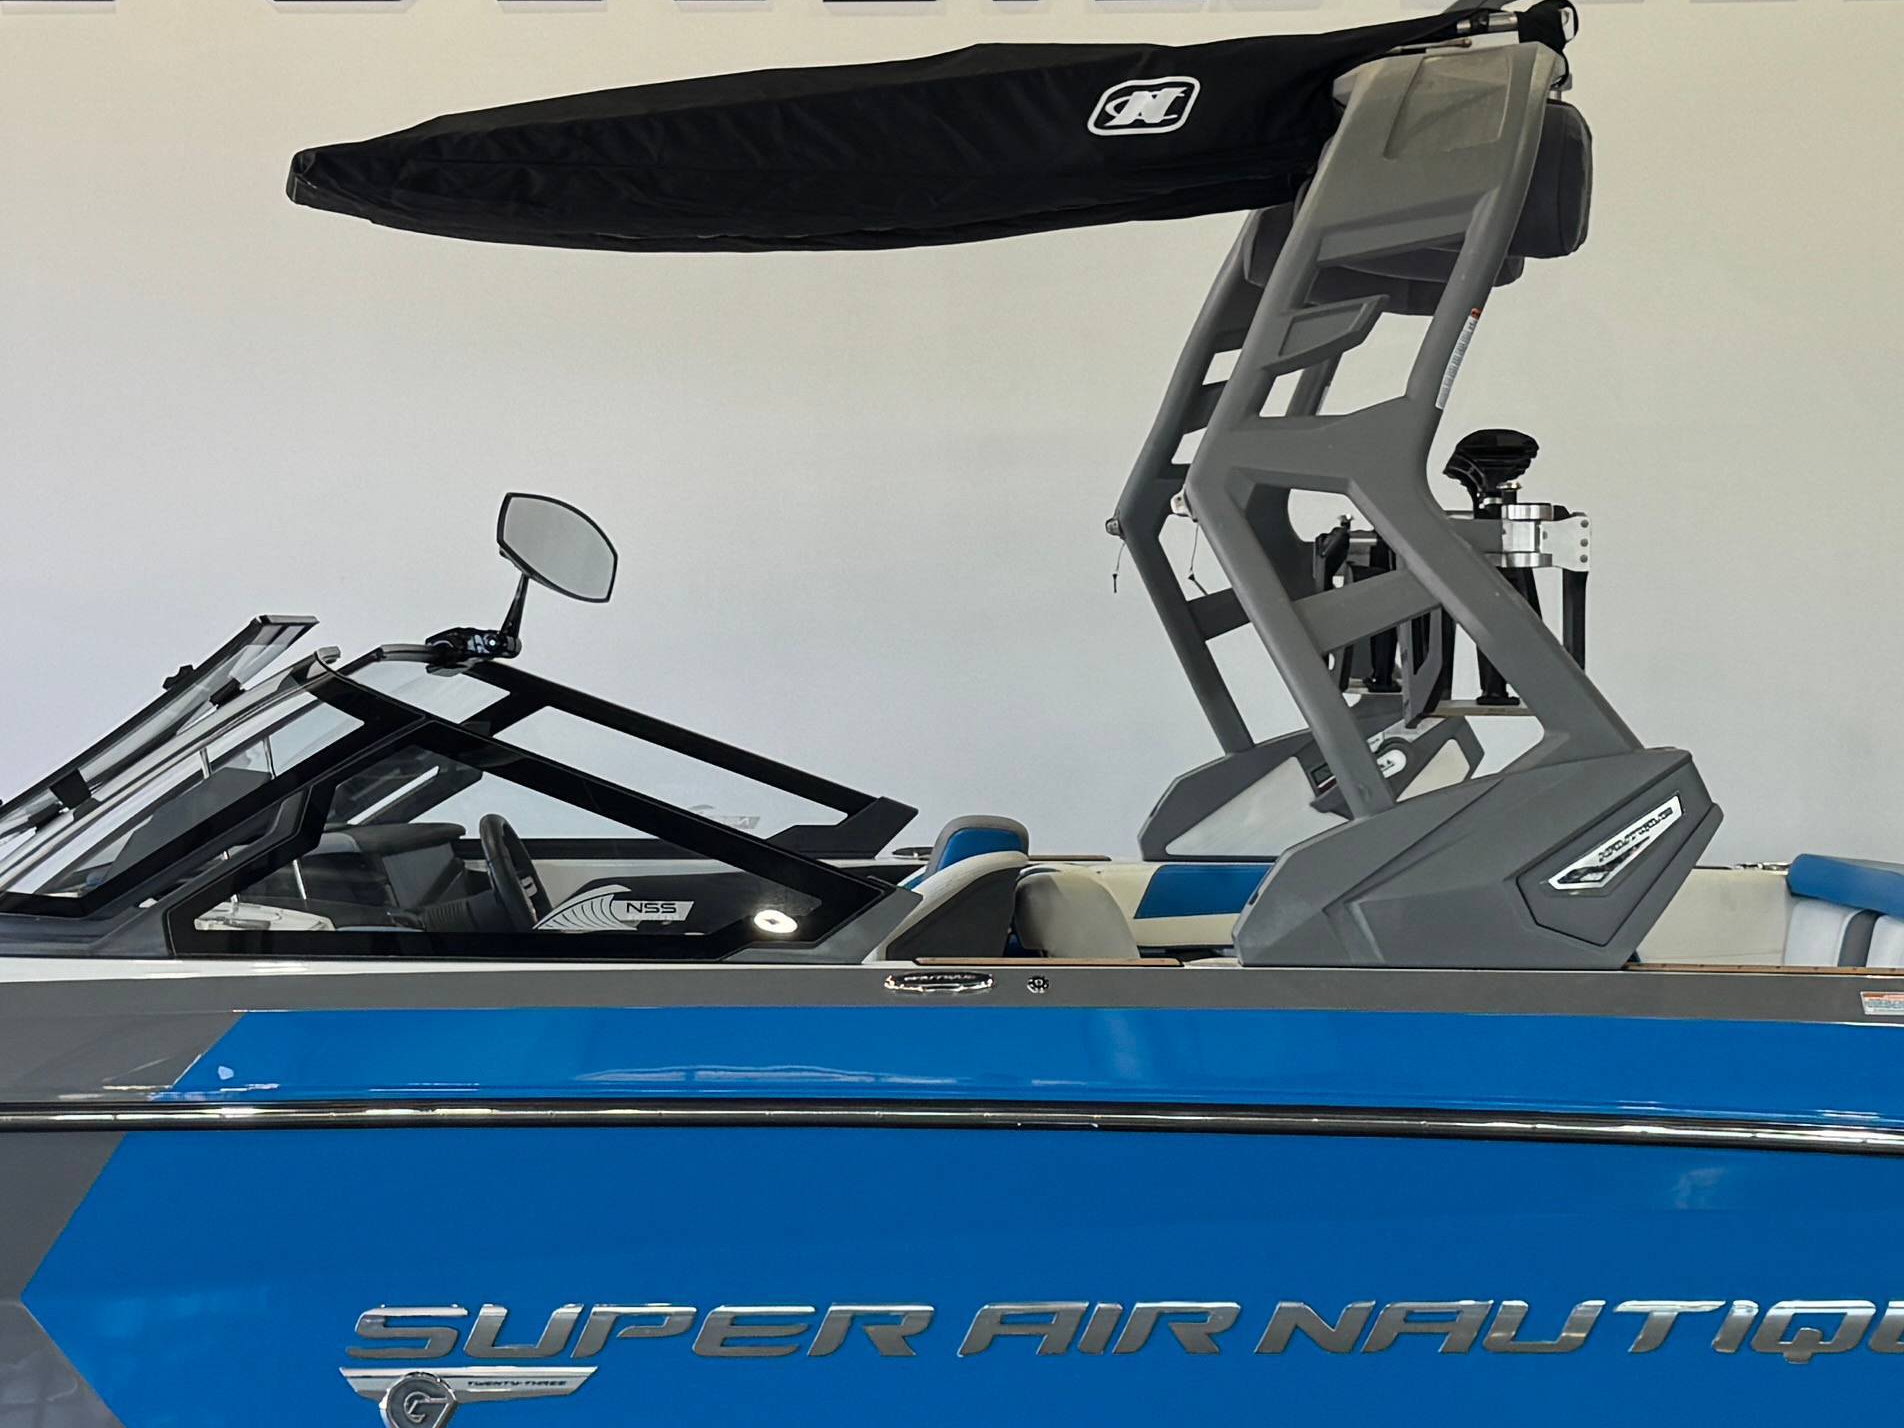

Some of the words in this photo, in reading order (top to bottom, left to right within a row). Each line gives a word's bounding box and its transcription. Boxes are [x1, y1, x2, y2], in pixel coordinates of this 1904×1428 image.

[626, 902, 677, 914] NSS
[345, 1304, 935, 1359] SUPER
[956, 1301, 1241, 1357] AIR
